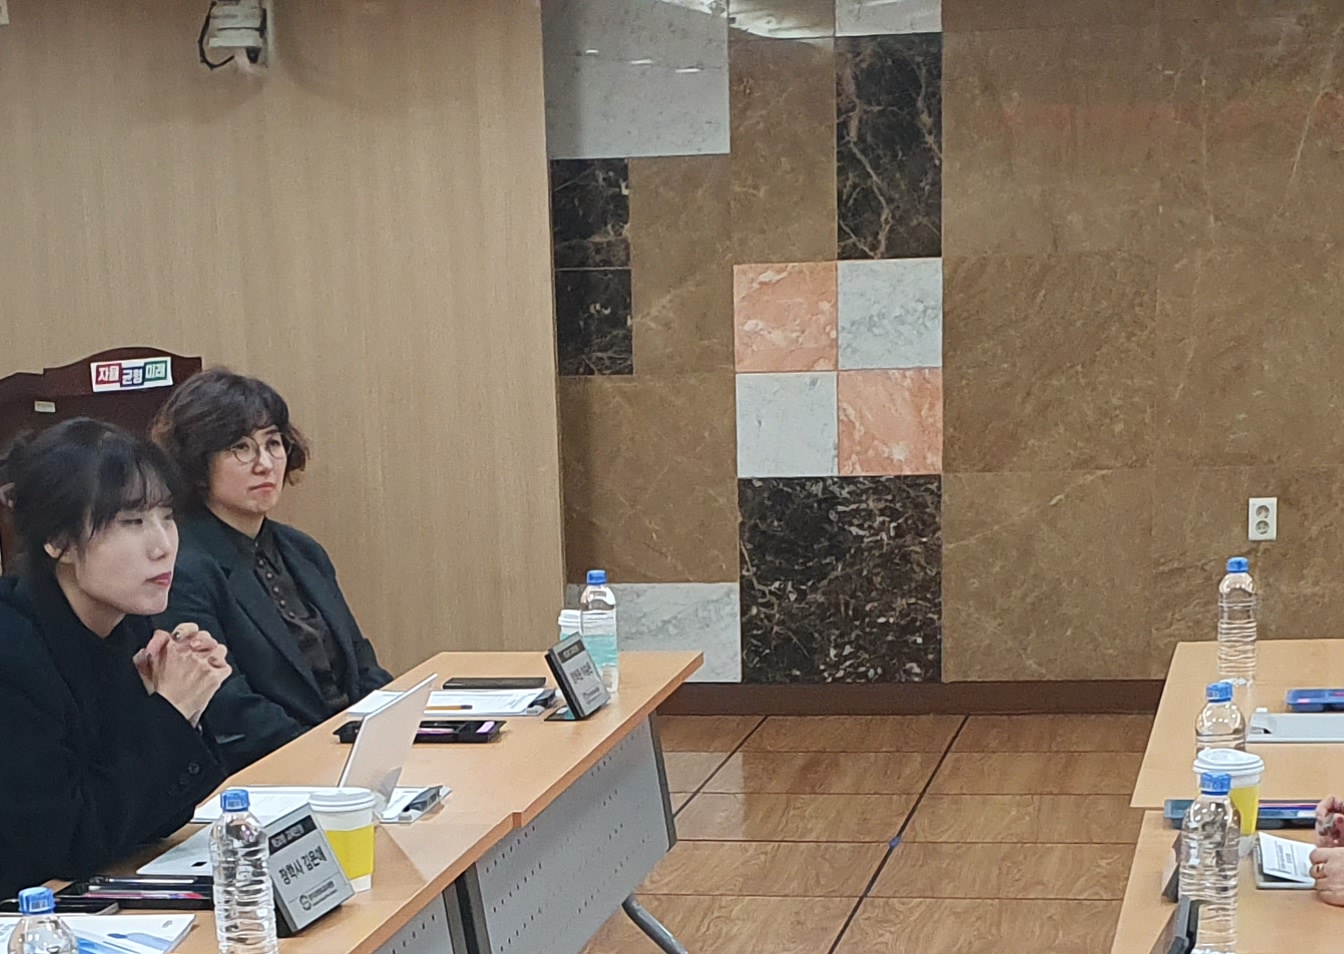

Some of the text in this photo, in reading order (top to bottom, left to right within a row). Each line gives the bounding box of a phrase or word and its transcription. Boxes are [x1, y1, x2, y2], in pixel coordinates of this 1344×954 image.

[97, 362, 166, 385] 자율 균형 미래
